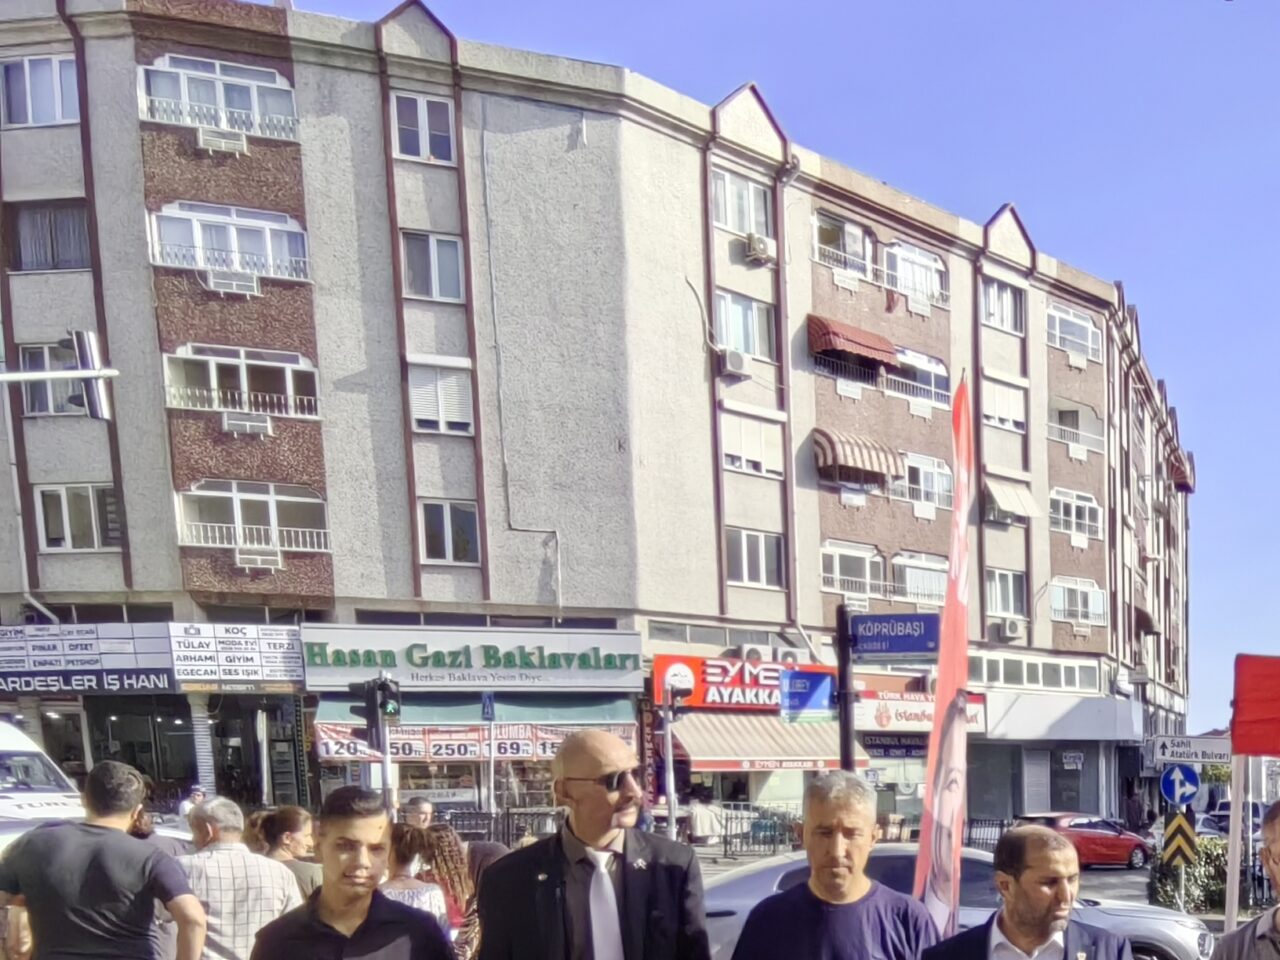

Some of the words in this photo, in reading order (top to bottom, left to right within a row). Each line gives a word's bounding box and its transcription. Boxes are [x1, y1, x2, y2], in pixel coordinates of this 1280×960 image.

[225, 626, 247, 637] KOÇ
[858, 619, 924, 637] KÖPRÜBAŞI
[176, 639, 211, 649] TÜLAY
[225, 655, 254, 663] GİYİM
[304, 641, 397, 669] Hasan
[406, 643, 473, 669] Gazi
[481, 643, 641, 671] Baklavaları
[177, 668, 217, 677] EGECAN
[222, 668, 240, 676] SES
[411, 672, 445, 682] Herkes
[448, 672, 487, 682] Baklava
[490, 673, 516, 682] Yesin
[705, 659, 799, 685] EYME
[103, 671, 120, 691] İŞ
[124, 673, 168, 689] HANI
[903, 692, 926, 702] HAVA
[321, 741, 357, 756] 120
[538, 741, 562, 755] 15
[1170, 739, 1191, 749] Sahil
[432, 743, 468, 757] 250
[1170, 750, 1199, 759] Atatürk
[1201, 750, 1229, 761] Bulvarı
